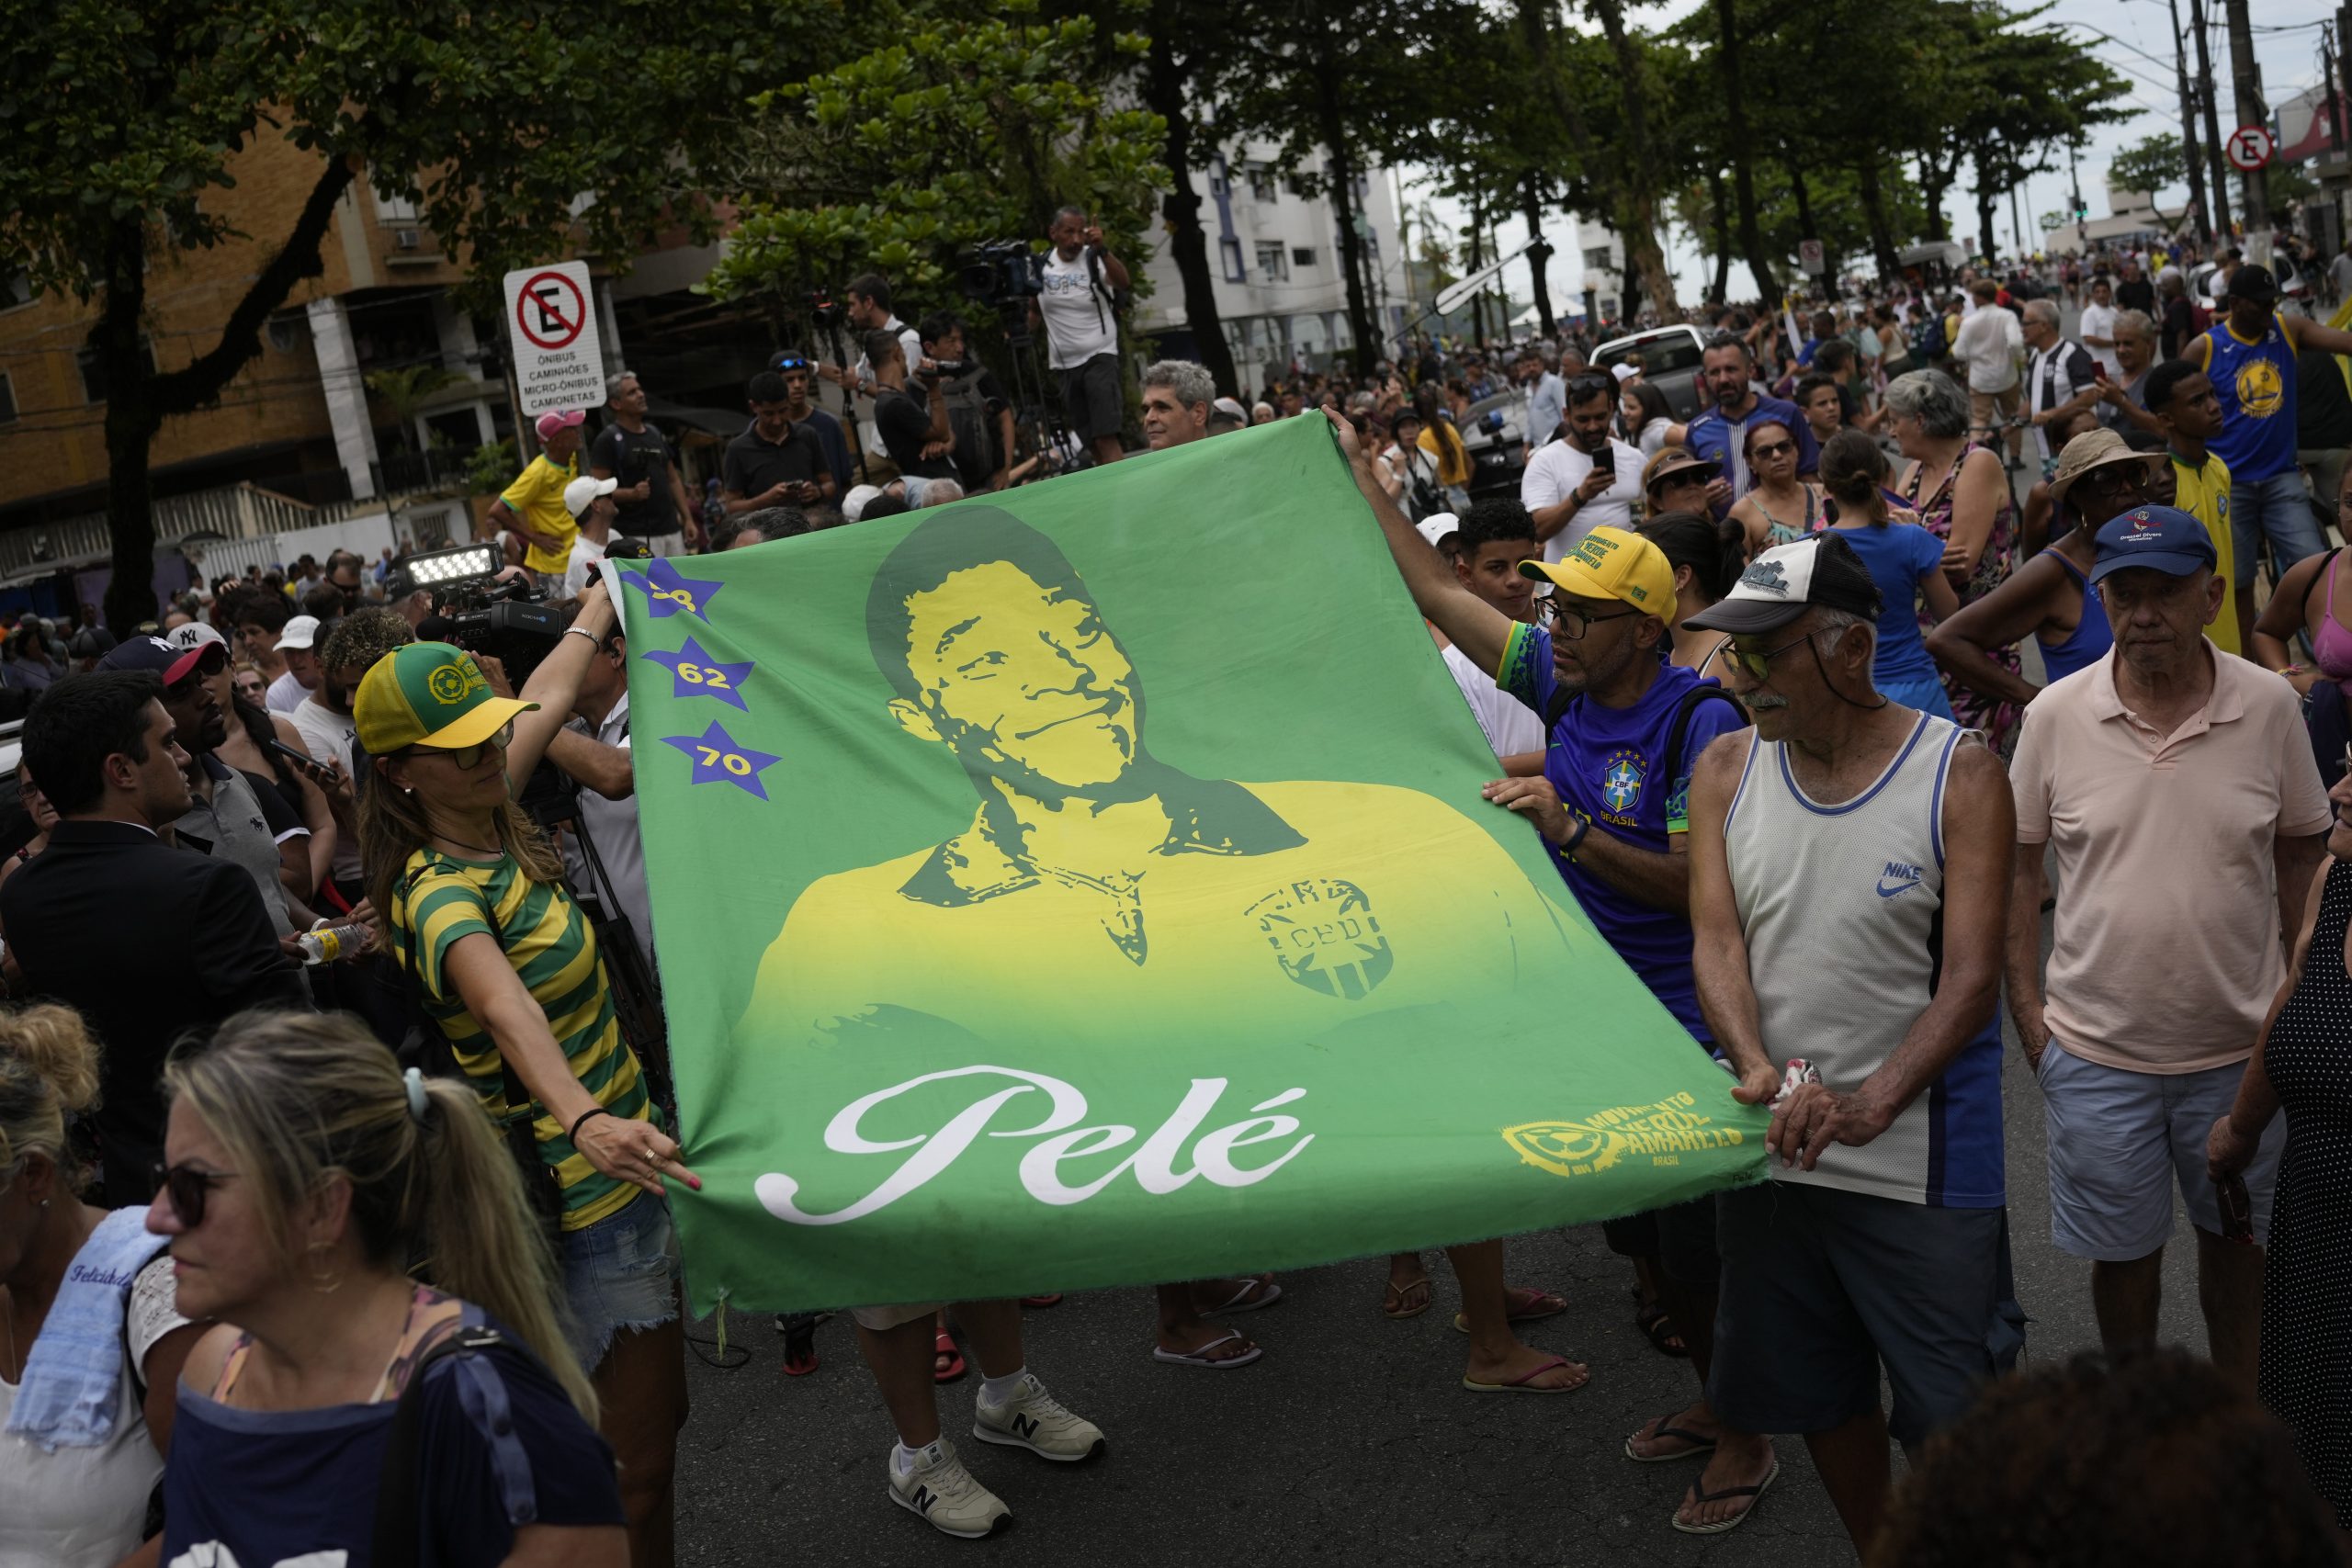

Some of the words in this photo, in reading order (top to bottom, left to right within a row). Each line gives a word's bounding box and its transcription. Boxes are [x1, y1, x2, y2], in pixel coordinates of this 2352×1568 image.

[537, 352, 576, 366] ÔNIBUS
[529, 364, 589, 381] CAMINHÕES
[524, 377, 599, 395] MICRO-ÔNIBUS
[530, 391, 596, 409] CAMIONETAS
[677, 662, 731, 690] 62
[696, 745, 752, 775] 70
[1600, 810, 1638, 827] BRASIL
[1883, 862, 1924, 881] NIKE
[753, 1064, 1316, 1226] Pelé
[1653, 1156, 1679, 1167] BRASIL
[1012, 1412, 1040, 1438] N
[910, 1483, 939, 1516] N
